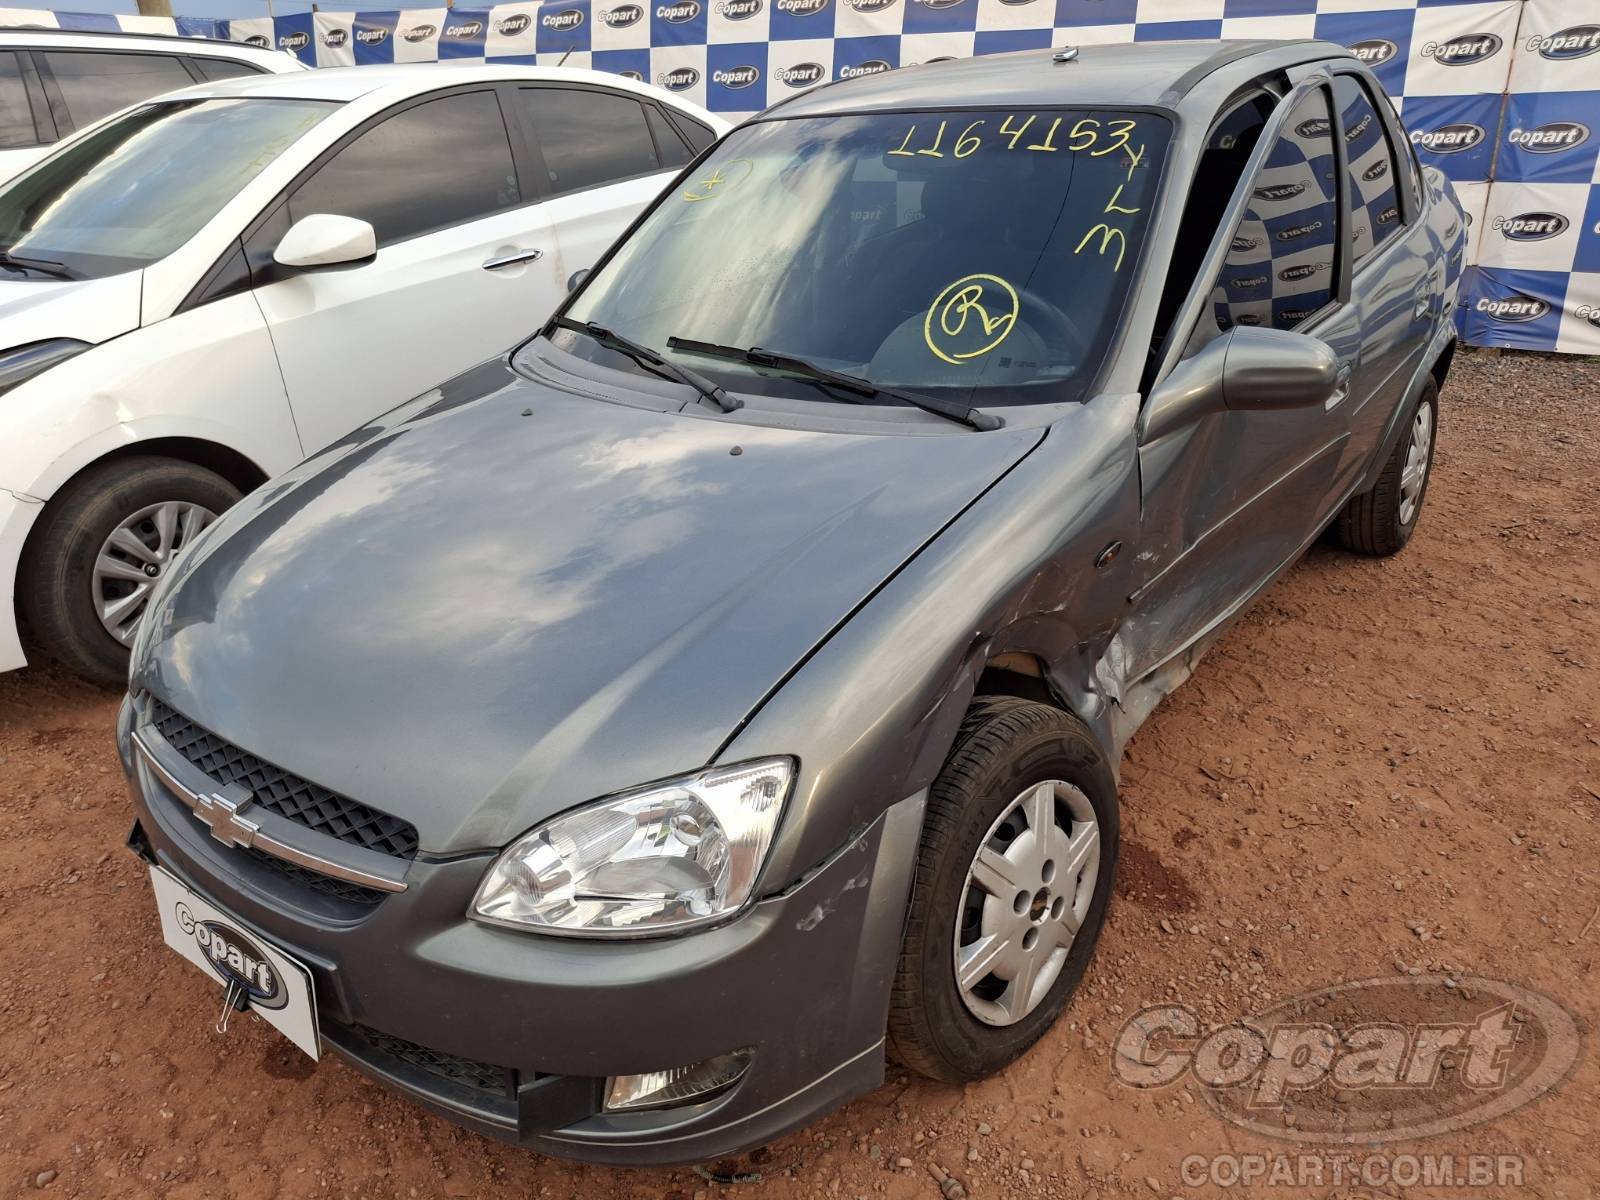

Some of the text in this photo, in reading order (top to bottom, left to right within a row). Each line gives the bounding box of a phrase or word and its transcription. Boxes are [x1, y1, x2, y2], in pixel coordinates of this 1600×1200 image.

[598, 7, 637, 25] Copart
[656, 2, 696, 20] Copart
[714, 0, 757, 15] Copart
[493, 16, 527, 33] Copart
[542, 12, 579, 28] Copart
[356, 28, 387, 43] Copart
[446, 24, 479, 37] Copart
[279, 34, 306, 48] Copart
[1421, 39, 1494, 59] Copart
[1526, 30, 1600, 54] Copart
[656, 71, 694, 88] Copart
[712, 69, 754, 84] Copart
[774, 66, 819, 83] Copart
[1409, 128, 1477, 148] Copart
[1508, 126, 1578, 147] Copart
[1492, 214, 1557, 234] Copart
[1476, 297, 1542, 317] Copart
[175, 901, 272, 996] Copart
